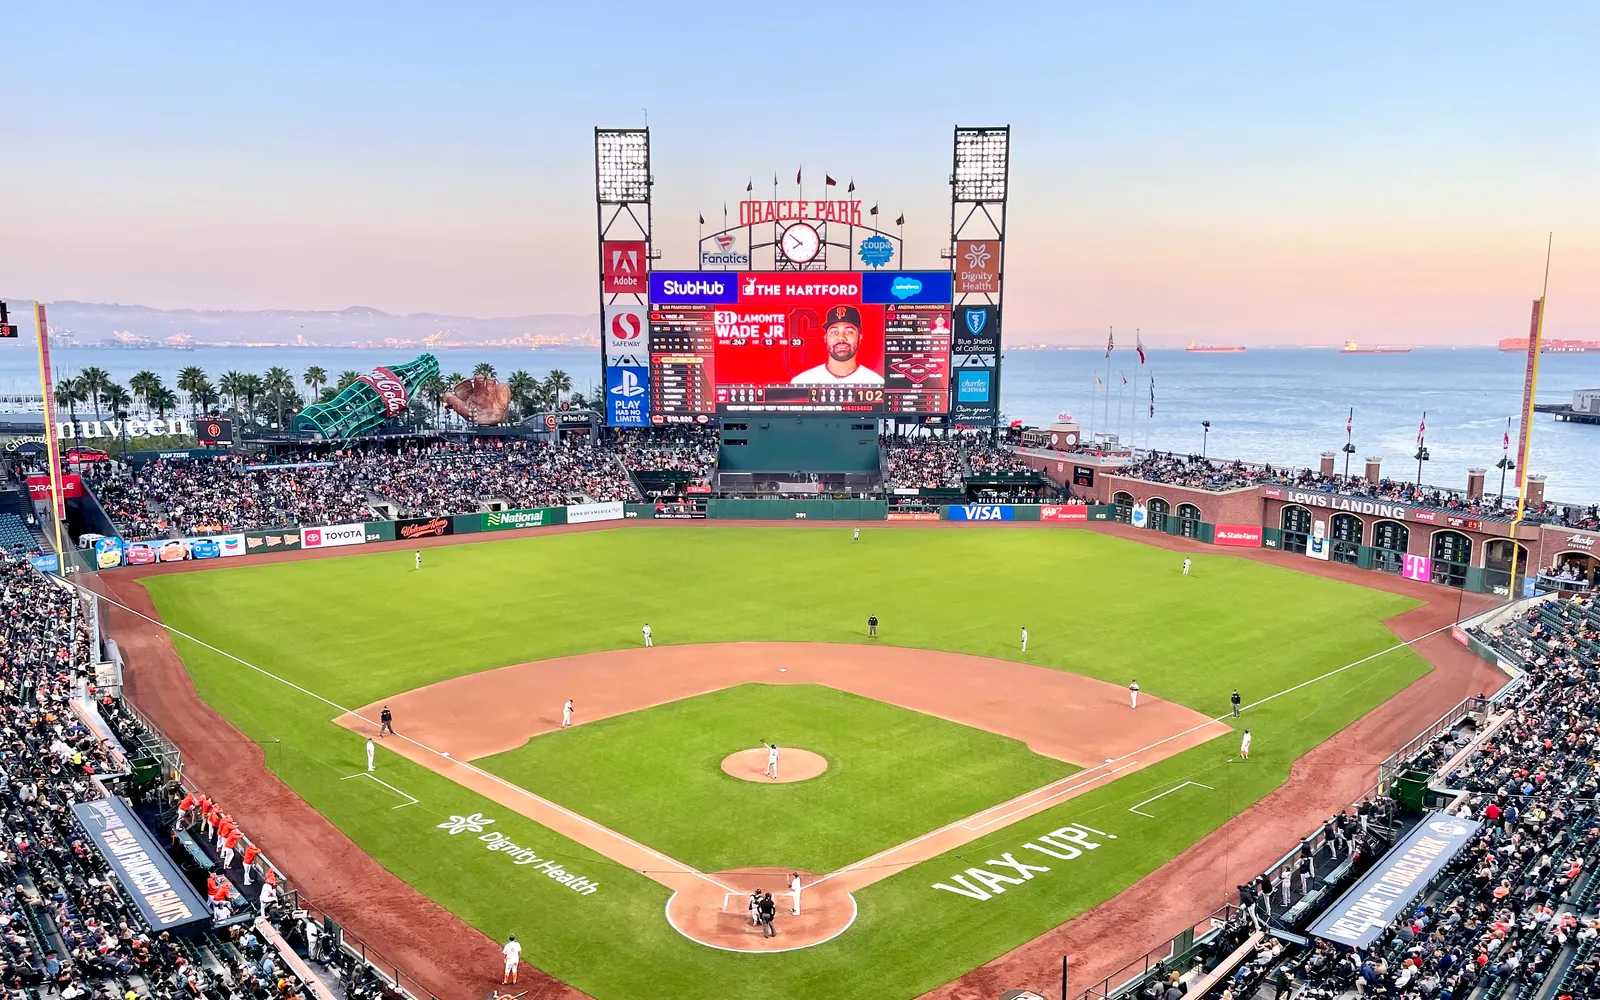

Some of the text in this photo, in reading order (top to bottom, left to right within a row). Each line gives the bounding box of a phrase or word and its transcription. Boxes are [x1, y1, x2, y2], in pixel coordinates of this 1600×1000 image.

[740, 200, 862, 227] ORACLE PARK
[864, 241, 891, 250] coupa
[702, 252, 748, 264] Fanatics
[614, 276, 638, 285] Adobe
[962, 272, 992, 282] Dignity
[664, 280, 724, 295] StubHub
[756, 285, 858, 296] THE HARTFORD
[962, 282, 992, 291] Health
[718, 313, 784, 324] 31 LAMONTE
[716, 325, 760, 338] WADE
[764, 325, 784, 338] JR
[615, 400, 640, 409] PLAY
[56, 418, 188, 439] nuveen
[29, 483, 74, 491] ORALE
[962, 506, 1002, 520] VISA
[1332, 498, 1404, 520] LANDING
[500, 510, 543, 523] National
[401, 517, 448, 536] Welcome Home
[324, 530, 362, 540] TOYOTA
[1566, 534, 1596, 546] Alaska
[1493, 586, 1509, 596] 309
[1408, 836, 1450, 859] PARK
[478, 832, 599, 896] Dignity Health
[930, 822, 1118, 901] VAX UP!
[1380, 856, 1432, 887] ORACLE
[117, 851, 171, 894] FRANCISCO
[144, 889, 192, 924] GIANTS
[1368, 883, 1405, 898] TO
[1325, 895, 1394, 940] WELCOME
